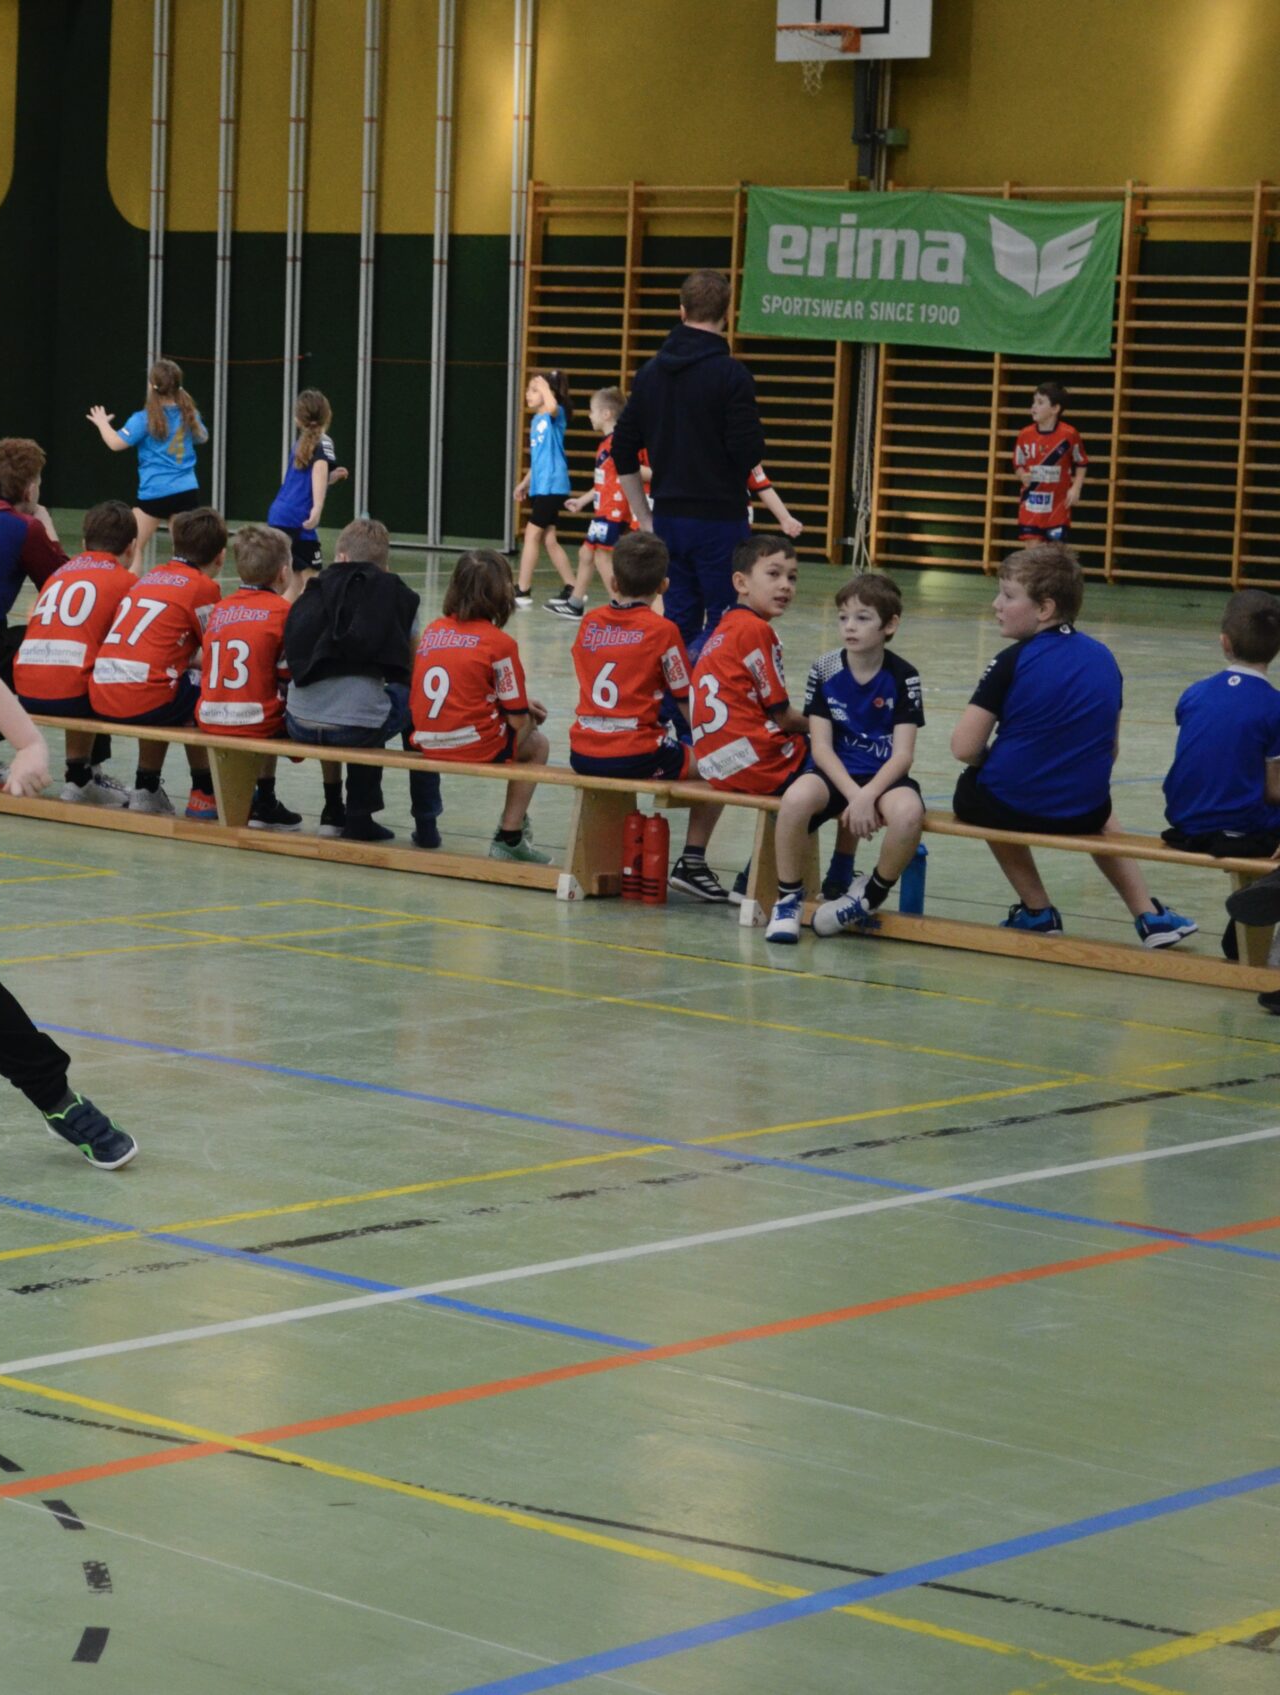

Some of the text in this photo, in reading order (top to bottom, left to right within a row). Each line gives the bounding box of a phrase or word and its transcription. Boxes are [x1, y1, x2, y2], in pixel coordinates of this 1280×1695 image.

[766, 213, 967, 284] erima
[761, 295, 960, 325] SPORTSWEAR SINCE 1900
[32, 580, 97, 628] 40
[103, 596, 168, 646] 27
[582, 621, 645, 652] Spiders
[208, 639, 251, 690] 13
[591, 661, 619, 710] 6
[422, 665, 450, 719] 9
